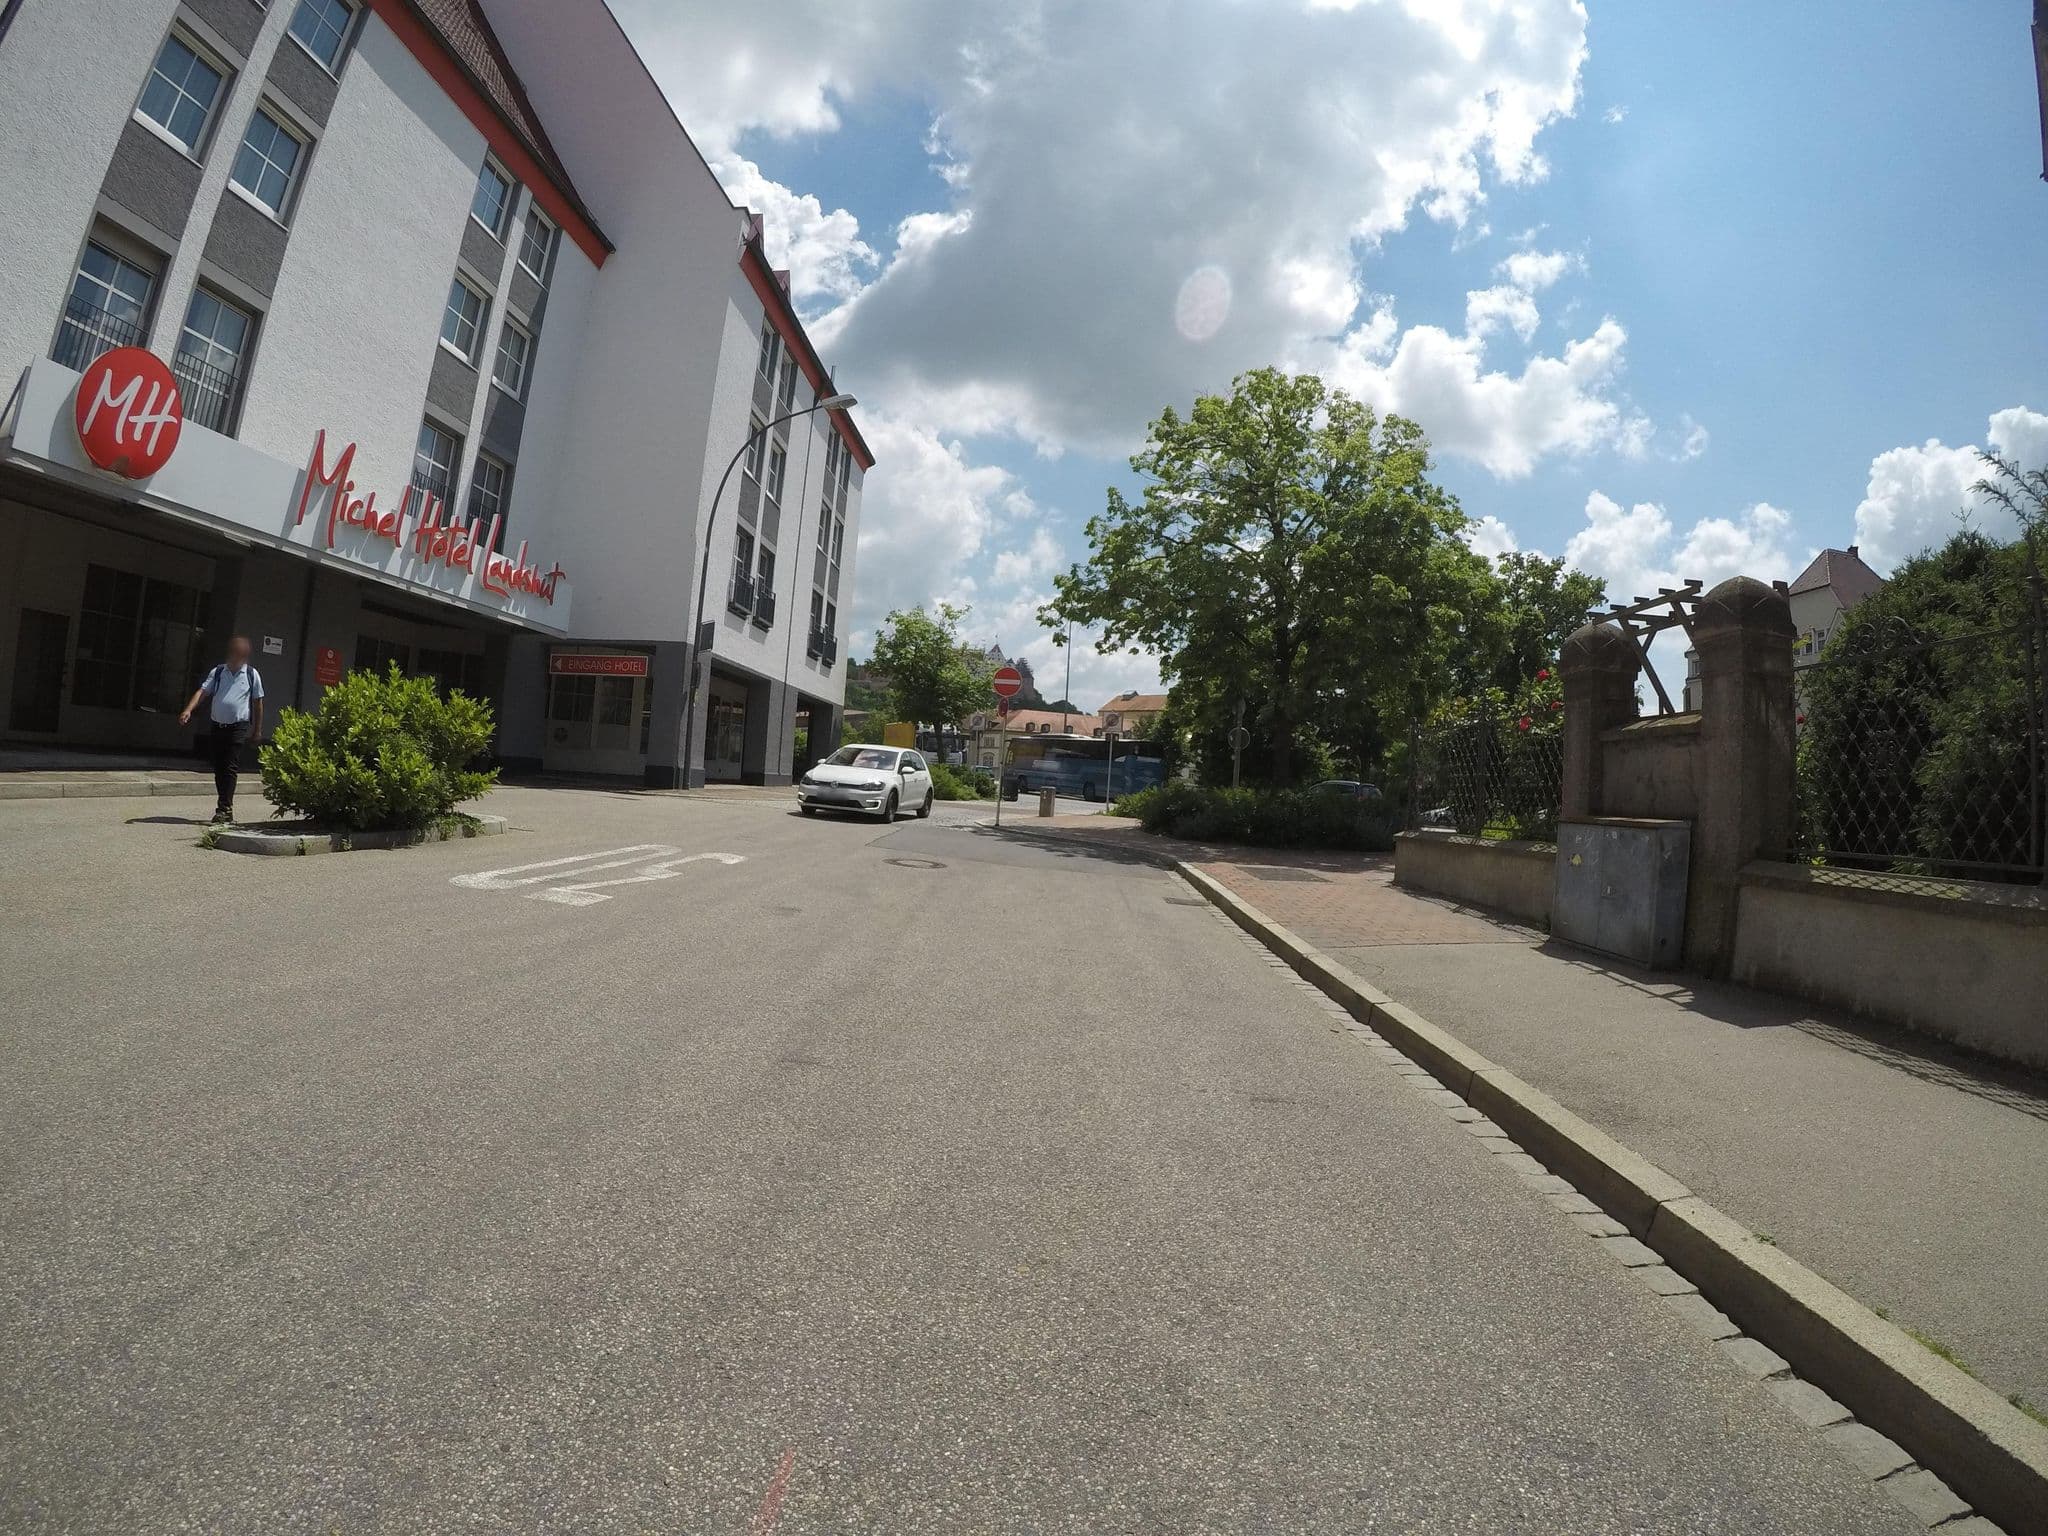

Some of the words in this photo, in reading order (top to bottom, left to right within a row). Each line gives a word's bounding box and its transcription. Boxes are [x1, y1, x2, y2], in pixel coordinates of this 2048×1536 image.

[83, 368, 178, 456] MH
[298, 429, 411, 549] Michel
[415, 490, 478, 575] Hotel
[482, 513, 566, 605] Landshut
[568, 660, 611, 671] EINGANG
[614, 661, 643, 672] HOTEL
